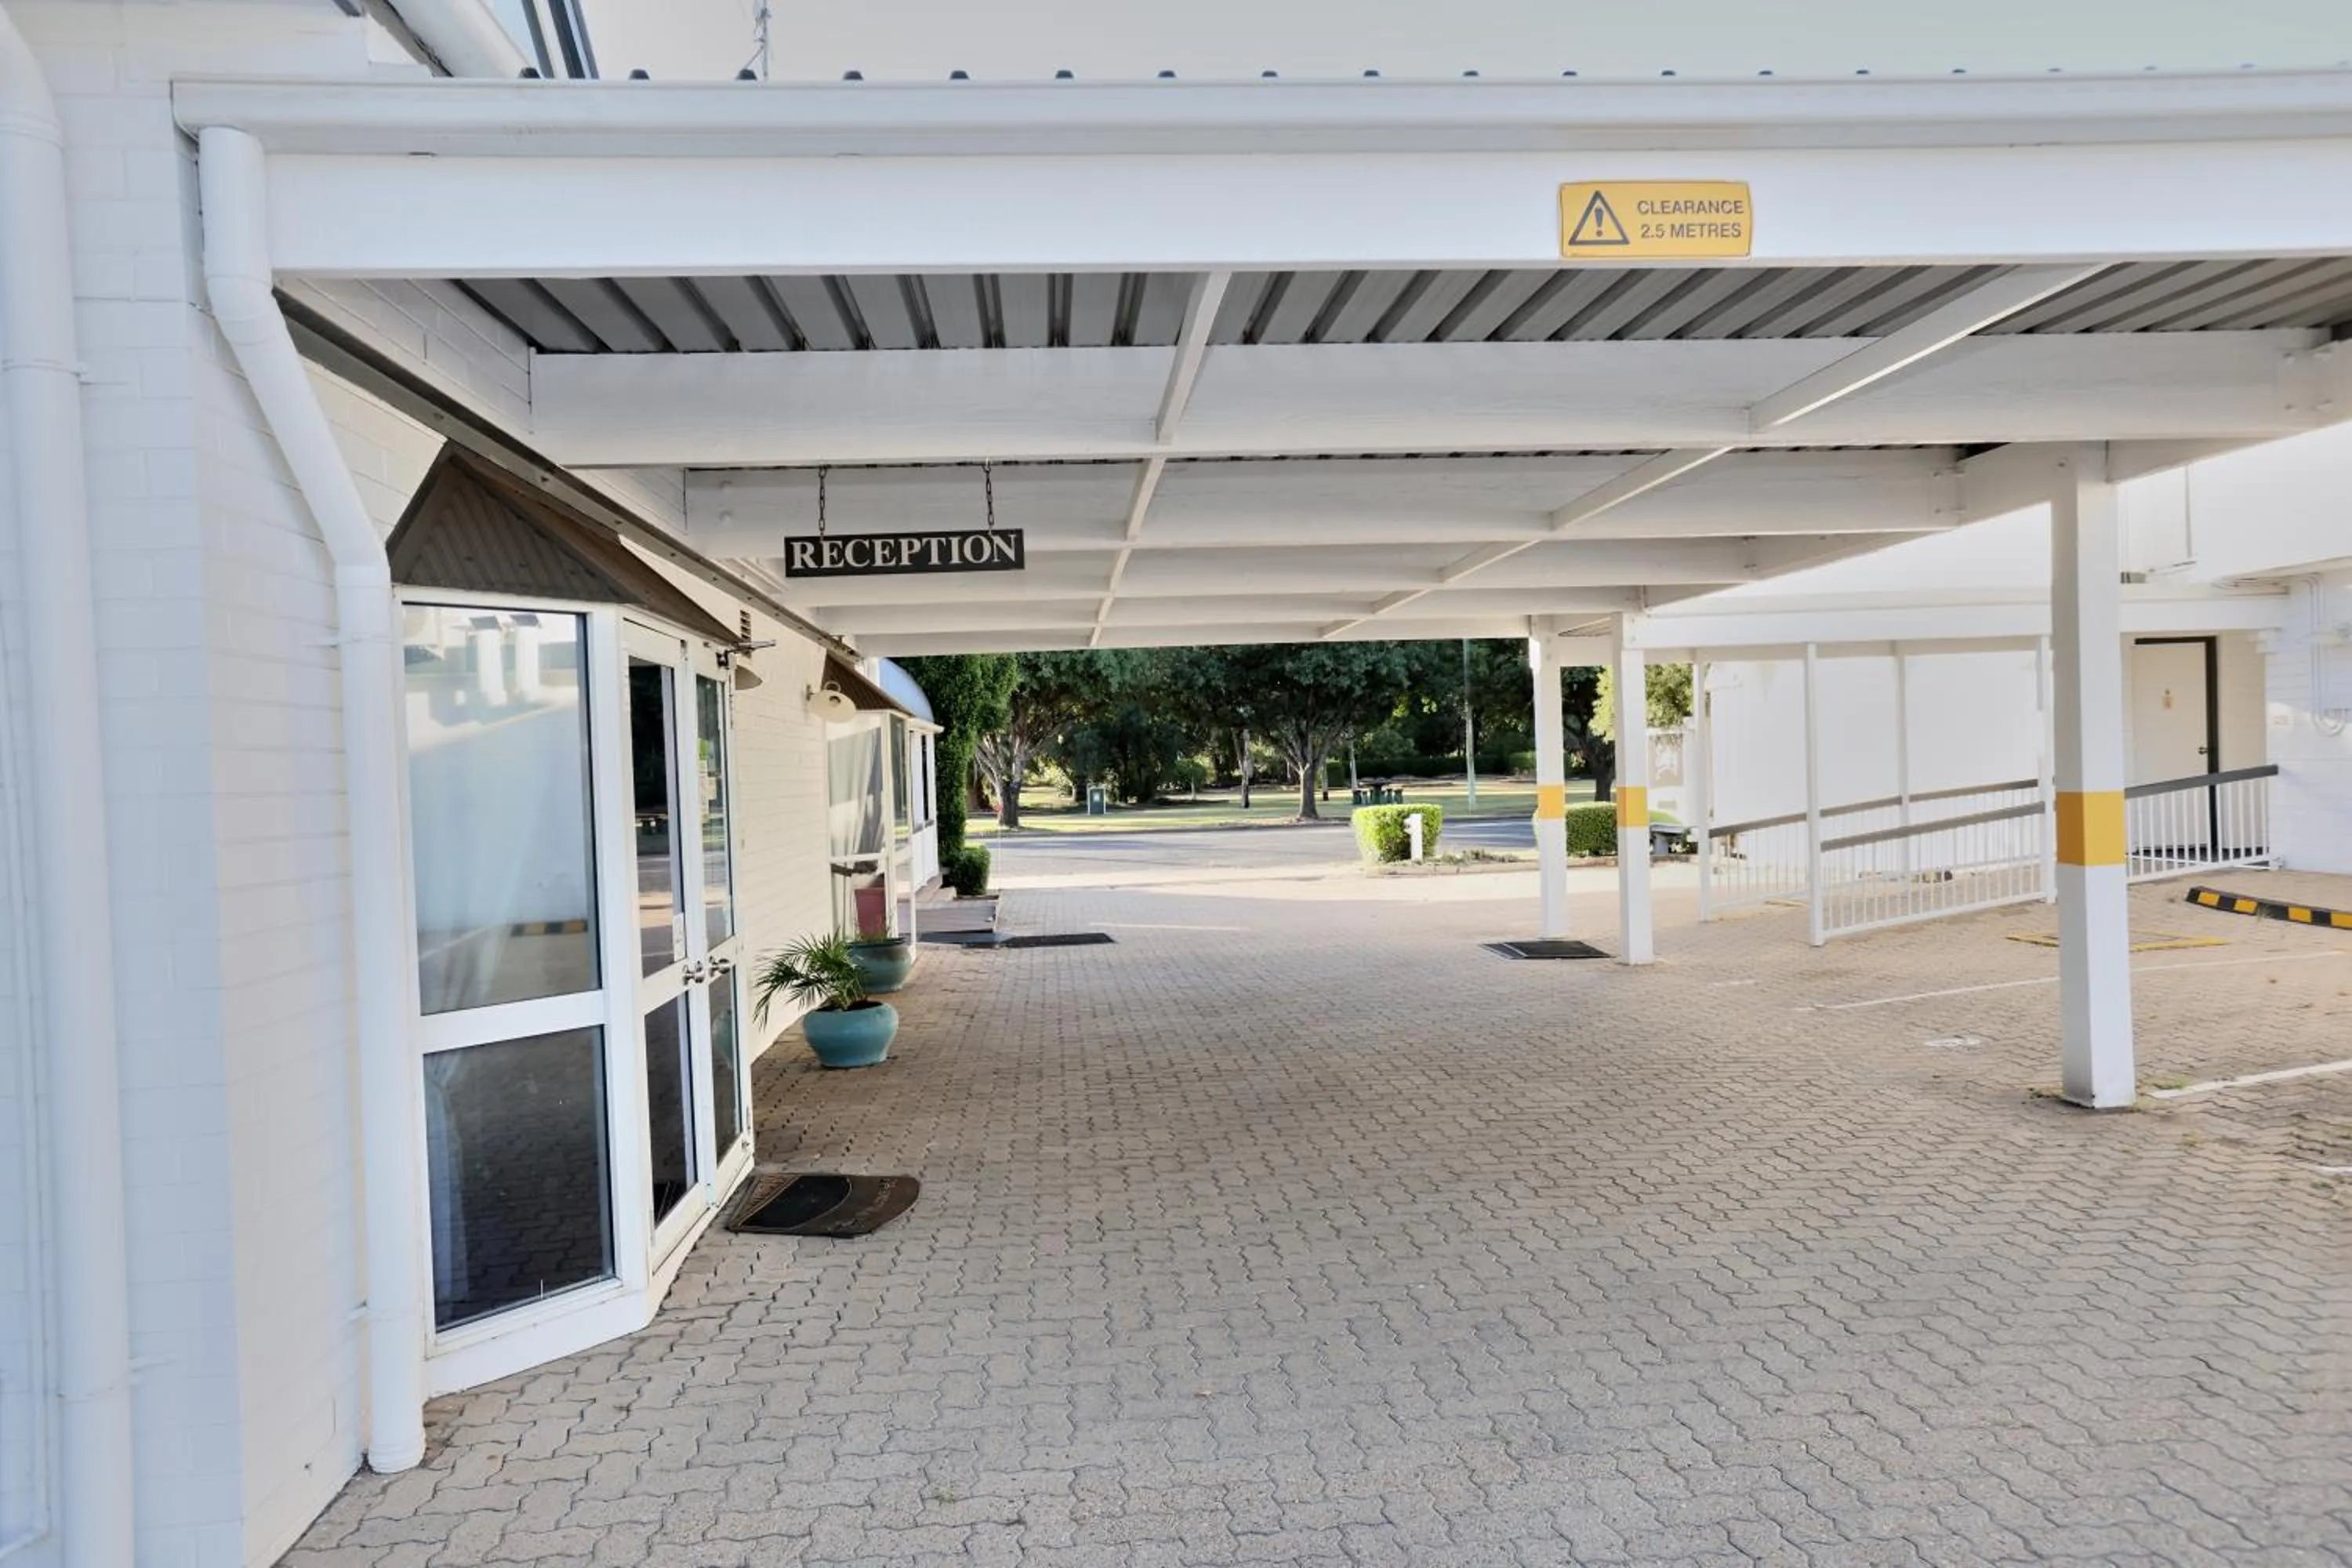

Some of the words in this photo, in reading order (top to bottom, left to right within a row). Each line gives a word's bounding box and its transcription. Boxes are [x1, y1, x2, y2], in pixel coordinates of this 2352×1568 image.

[1637, 201, 1744, 214] CLEARANCE
[1641, 224, 1665, 238] 2.5
[1671, 223, 1741, 238] METRES
[790, 534, 1017, 569] RECEPTION
